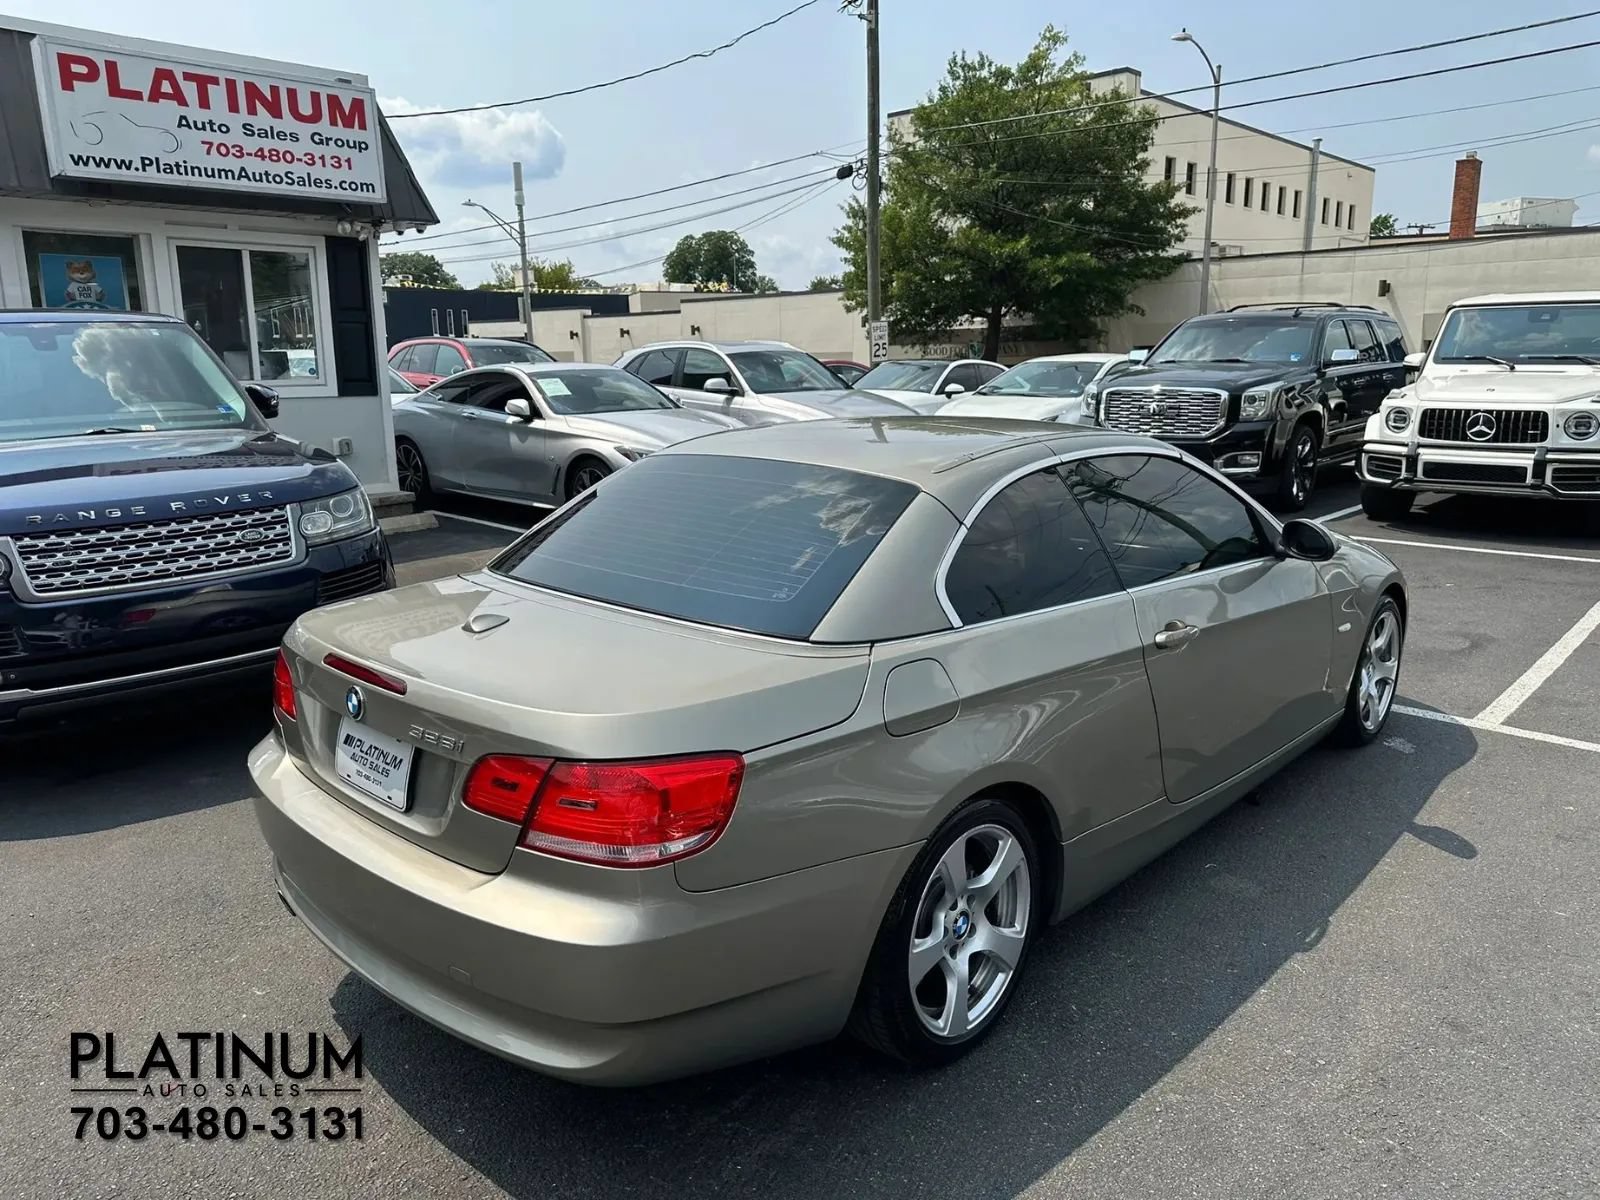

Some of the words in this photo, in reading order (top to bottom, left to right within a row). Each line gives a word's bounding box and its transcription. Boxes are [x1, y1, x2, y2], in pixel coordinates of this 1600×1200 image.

[56, 51, 368, 131] PLATINUM
[176, 114, 231, 134] Auto
[241, 122, 300, 143] Sales
[310, 131, 369, 153] Group
[200, 140, 353, 171] 703-480-3131
[68, 153, 376, 193] www.PlatinumAutoSales.com
[872, 324, 888, 333] SPEED
[873, 342, 888, 358] 25
[25, 505, 147, 525] RANGE
[169, 490, 273, 512] ROVER
[352, 738, 404, 771] PLATINUM
[408, 724, 465, 753] 328i
[350, 752, 369, 767] AUTO
[368, 761, 391, 778] SALES
